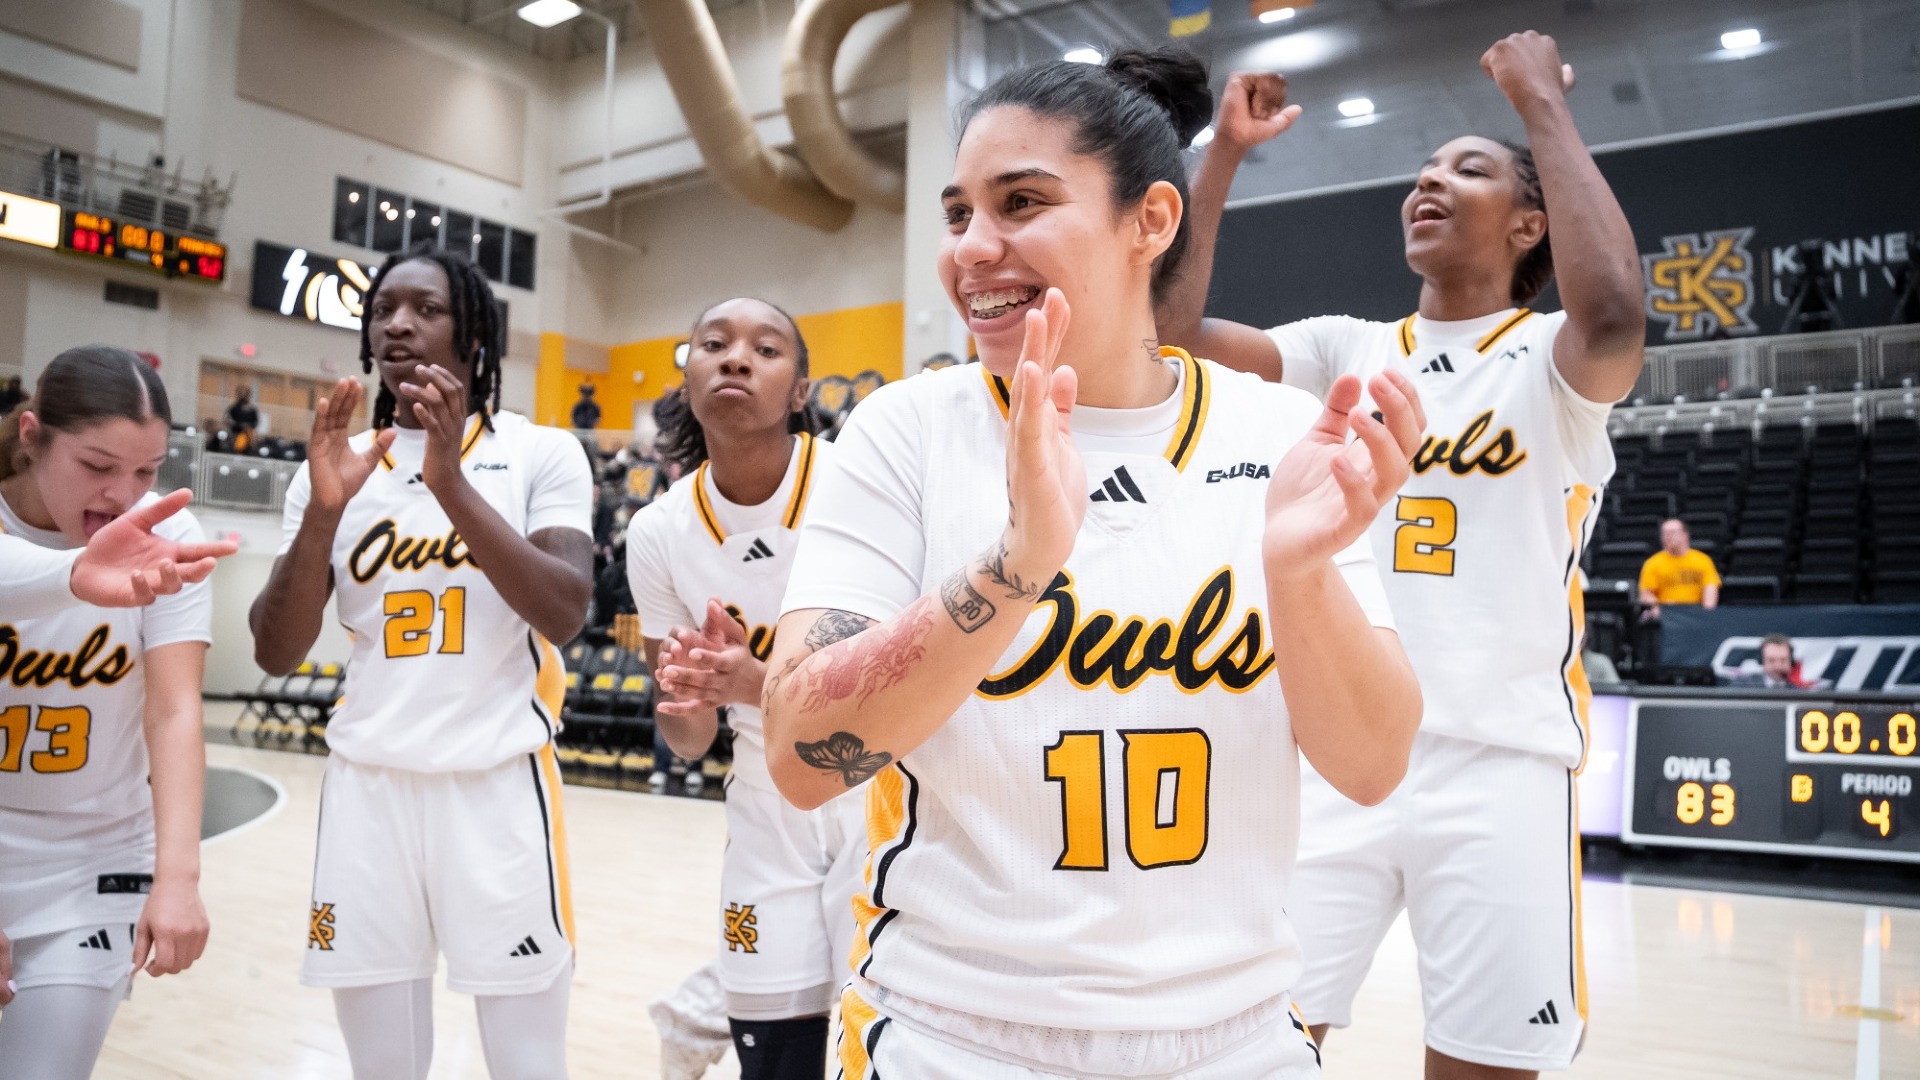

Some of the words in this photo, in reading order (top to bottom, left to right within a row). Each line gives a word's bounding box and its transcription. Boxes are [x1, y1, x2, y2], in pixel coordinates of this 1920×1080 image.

[1772, 231, 1909, 275] KNNE
[1408, 407, 1528, 478] wls
[347, 516, 482, 584] Owl
[1393, 494, 1457, 576] 2
[383, 586, 466, 659] 21
[975, 563, 1276, 701] Owls
[0, 705, 92, 773] 13
[1801, 711, 1917, 756] 00.0
[1043, 727, 1213, 872] 10
[1663, 756, 1731, 781] OWLS
[1841, 773, 1912, 796] PERIOD
[1677, 782, 1736, 826] 83
[1862, 799, 1890, 837] 4
